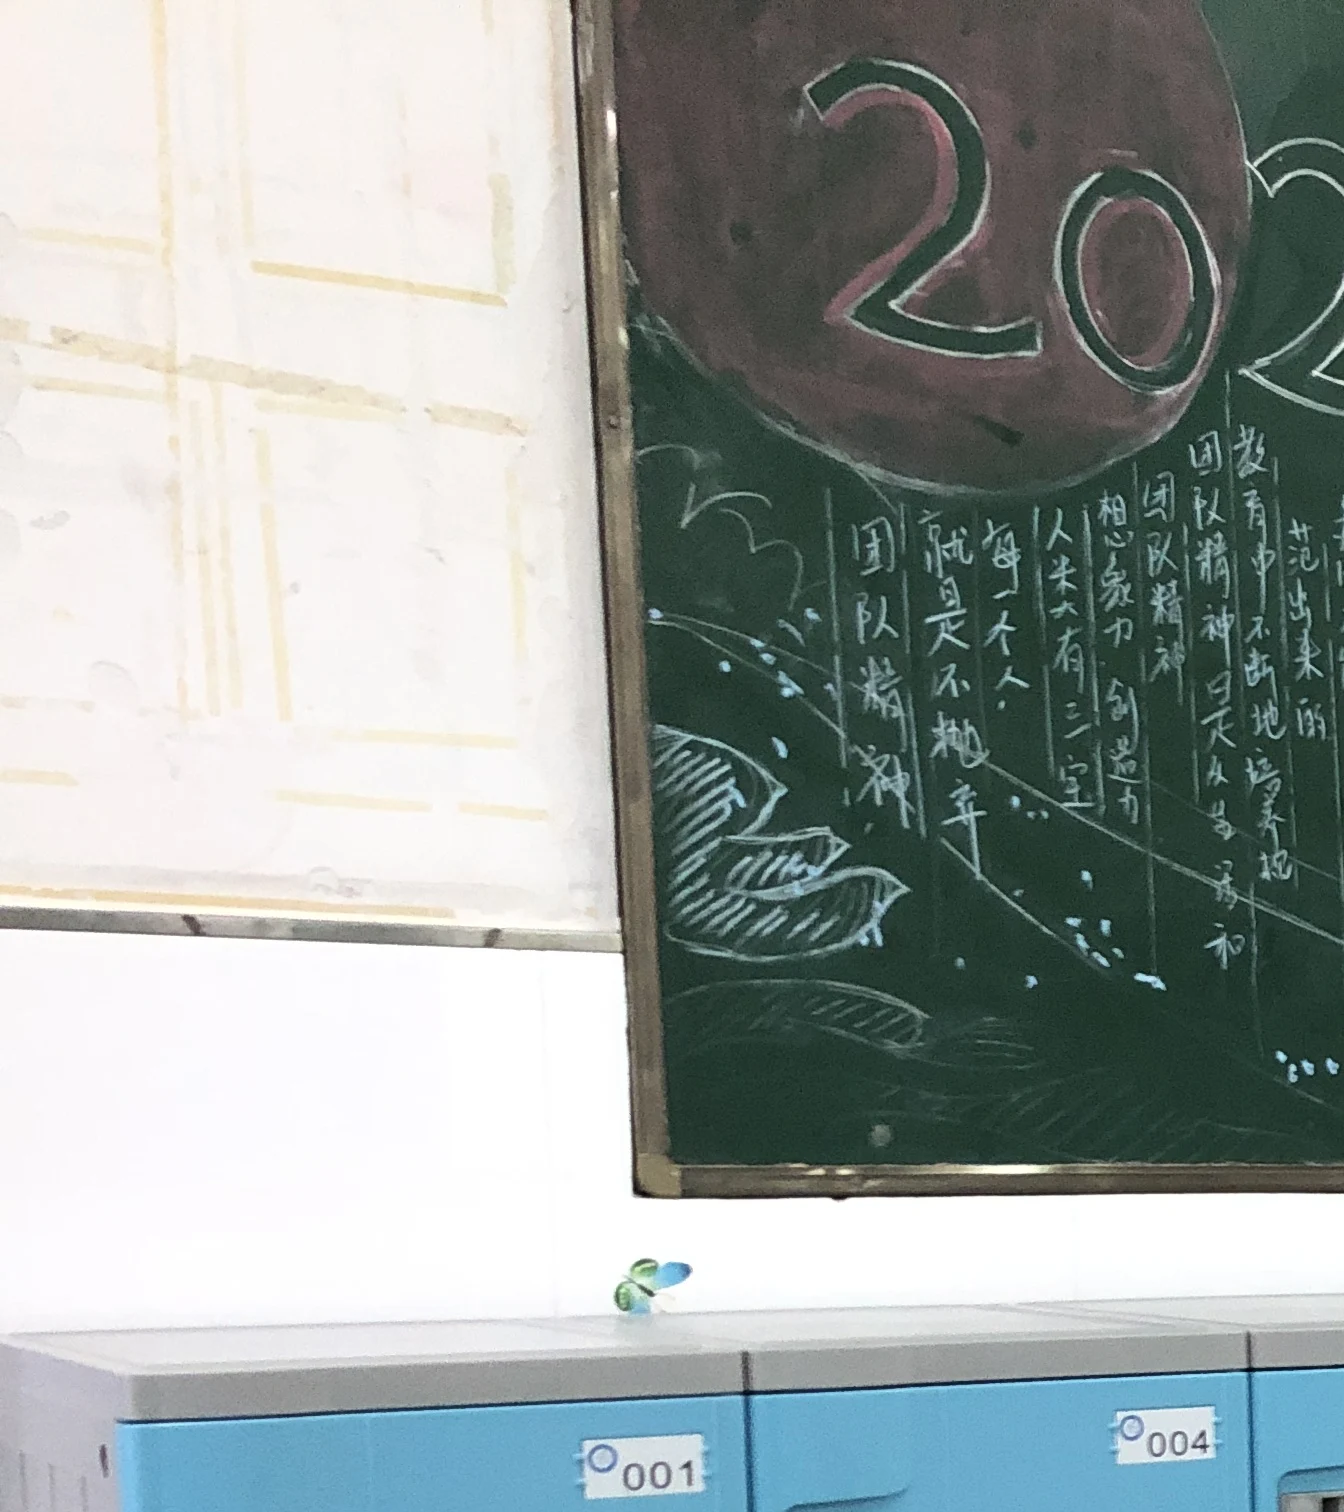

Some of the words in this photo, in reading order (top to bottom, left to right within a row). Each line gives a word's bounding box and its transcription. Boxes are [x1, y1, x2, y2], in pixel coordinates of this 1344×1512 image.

[1143, 471, 1187, 706] 团队精神
[851, 515, 915, 829] 团队精神
[622, 1461, 697, 1492] 001
[1147, 1430, 1211, 1458] 004
